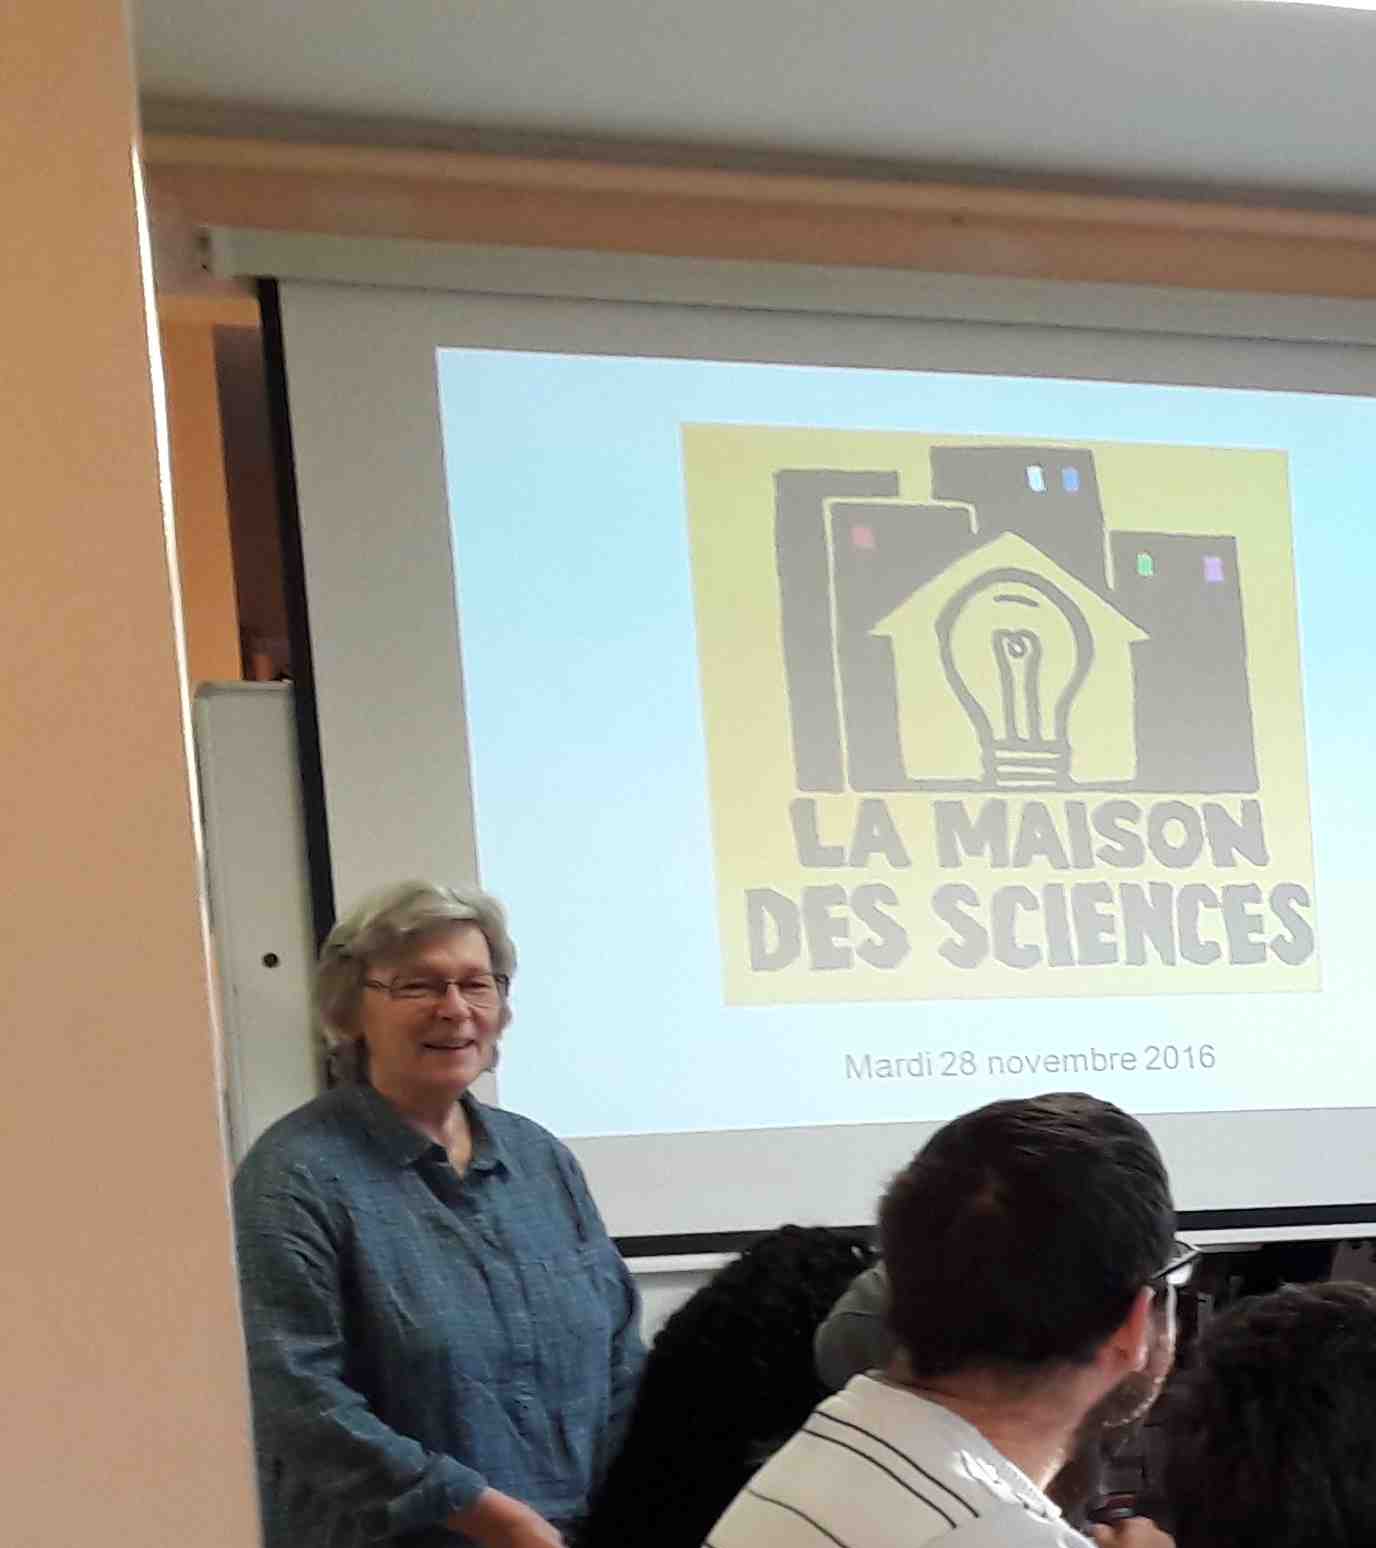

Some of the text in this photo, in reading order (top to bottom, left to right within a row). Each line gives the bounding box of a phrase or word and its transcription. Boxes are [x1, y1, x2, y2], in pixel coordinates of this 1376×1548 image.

[789, 797, 1271, 871] LA MAISON
[744, 880, 1316, 973] DES SCIENCES
[844, 1043, 1217, 1081] Mardi 28 novembre 2016
